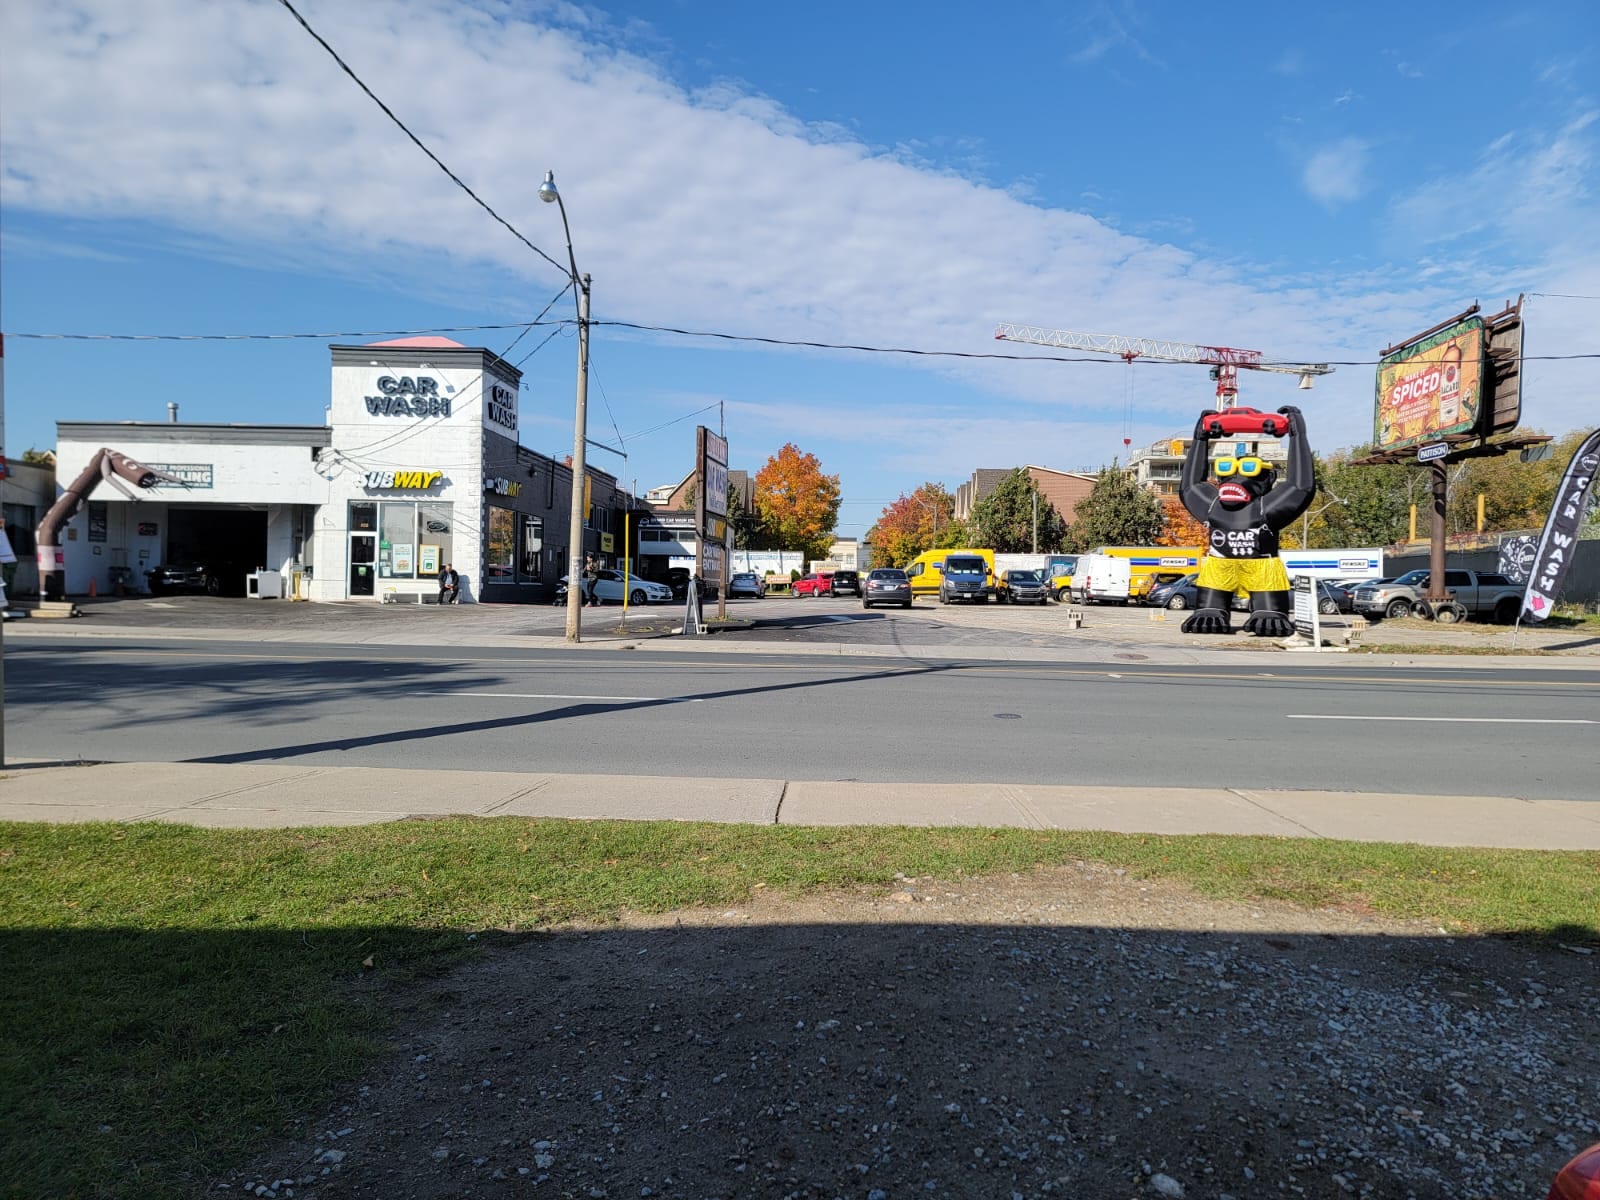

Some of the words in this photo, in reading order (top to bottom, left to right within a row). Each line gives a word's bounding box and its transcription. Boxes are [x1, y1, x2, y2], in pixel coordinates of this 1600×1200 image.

[377, 375, 439, 397] CAR
[492, 385, 514, 409] CAR
[1391, 371, 1440, 406] SPICED
[364, 396, 452, 418] WASH
[488, 402, 518, 431] WASH
[1420, 446, 1446, 459] PATTISON
[357, 470, 443, 490] SUBWAY
[495, 477, 522, 498] SUBWAY
[1563, 476, 1589, 519] CAR
[1227, 531, 1255, 541] CAR
[1227, 540, 1255, 548] WASH
[1540, 531, 1572, 592] WASH
